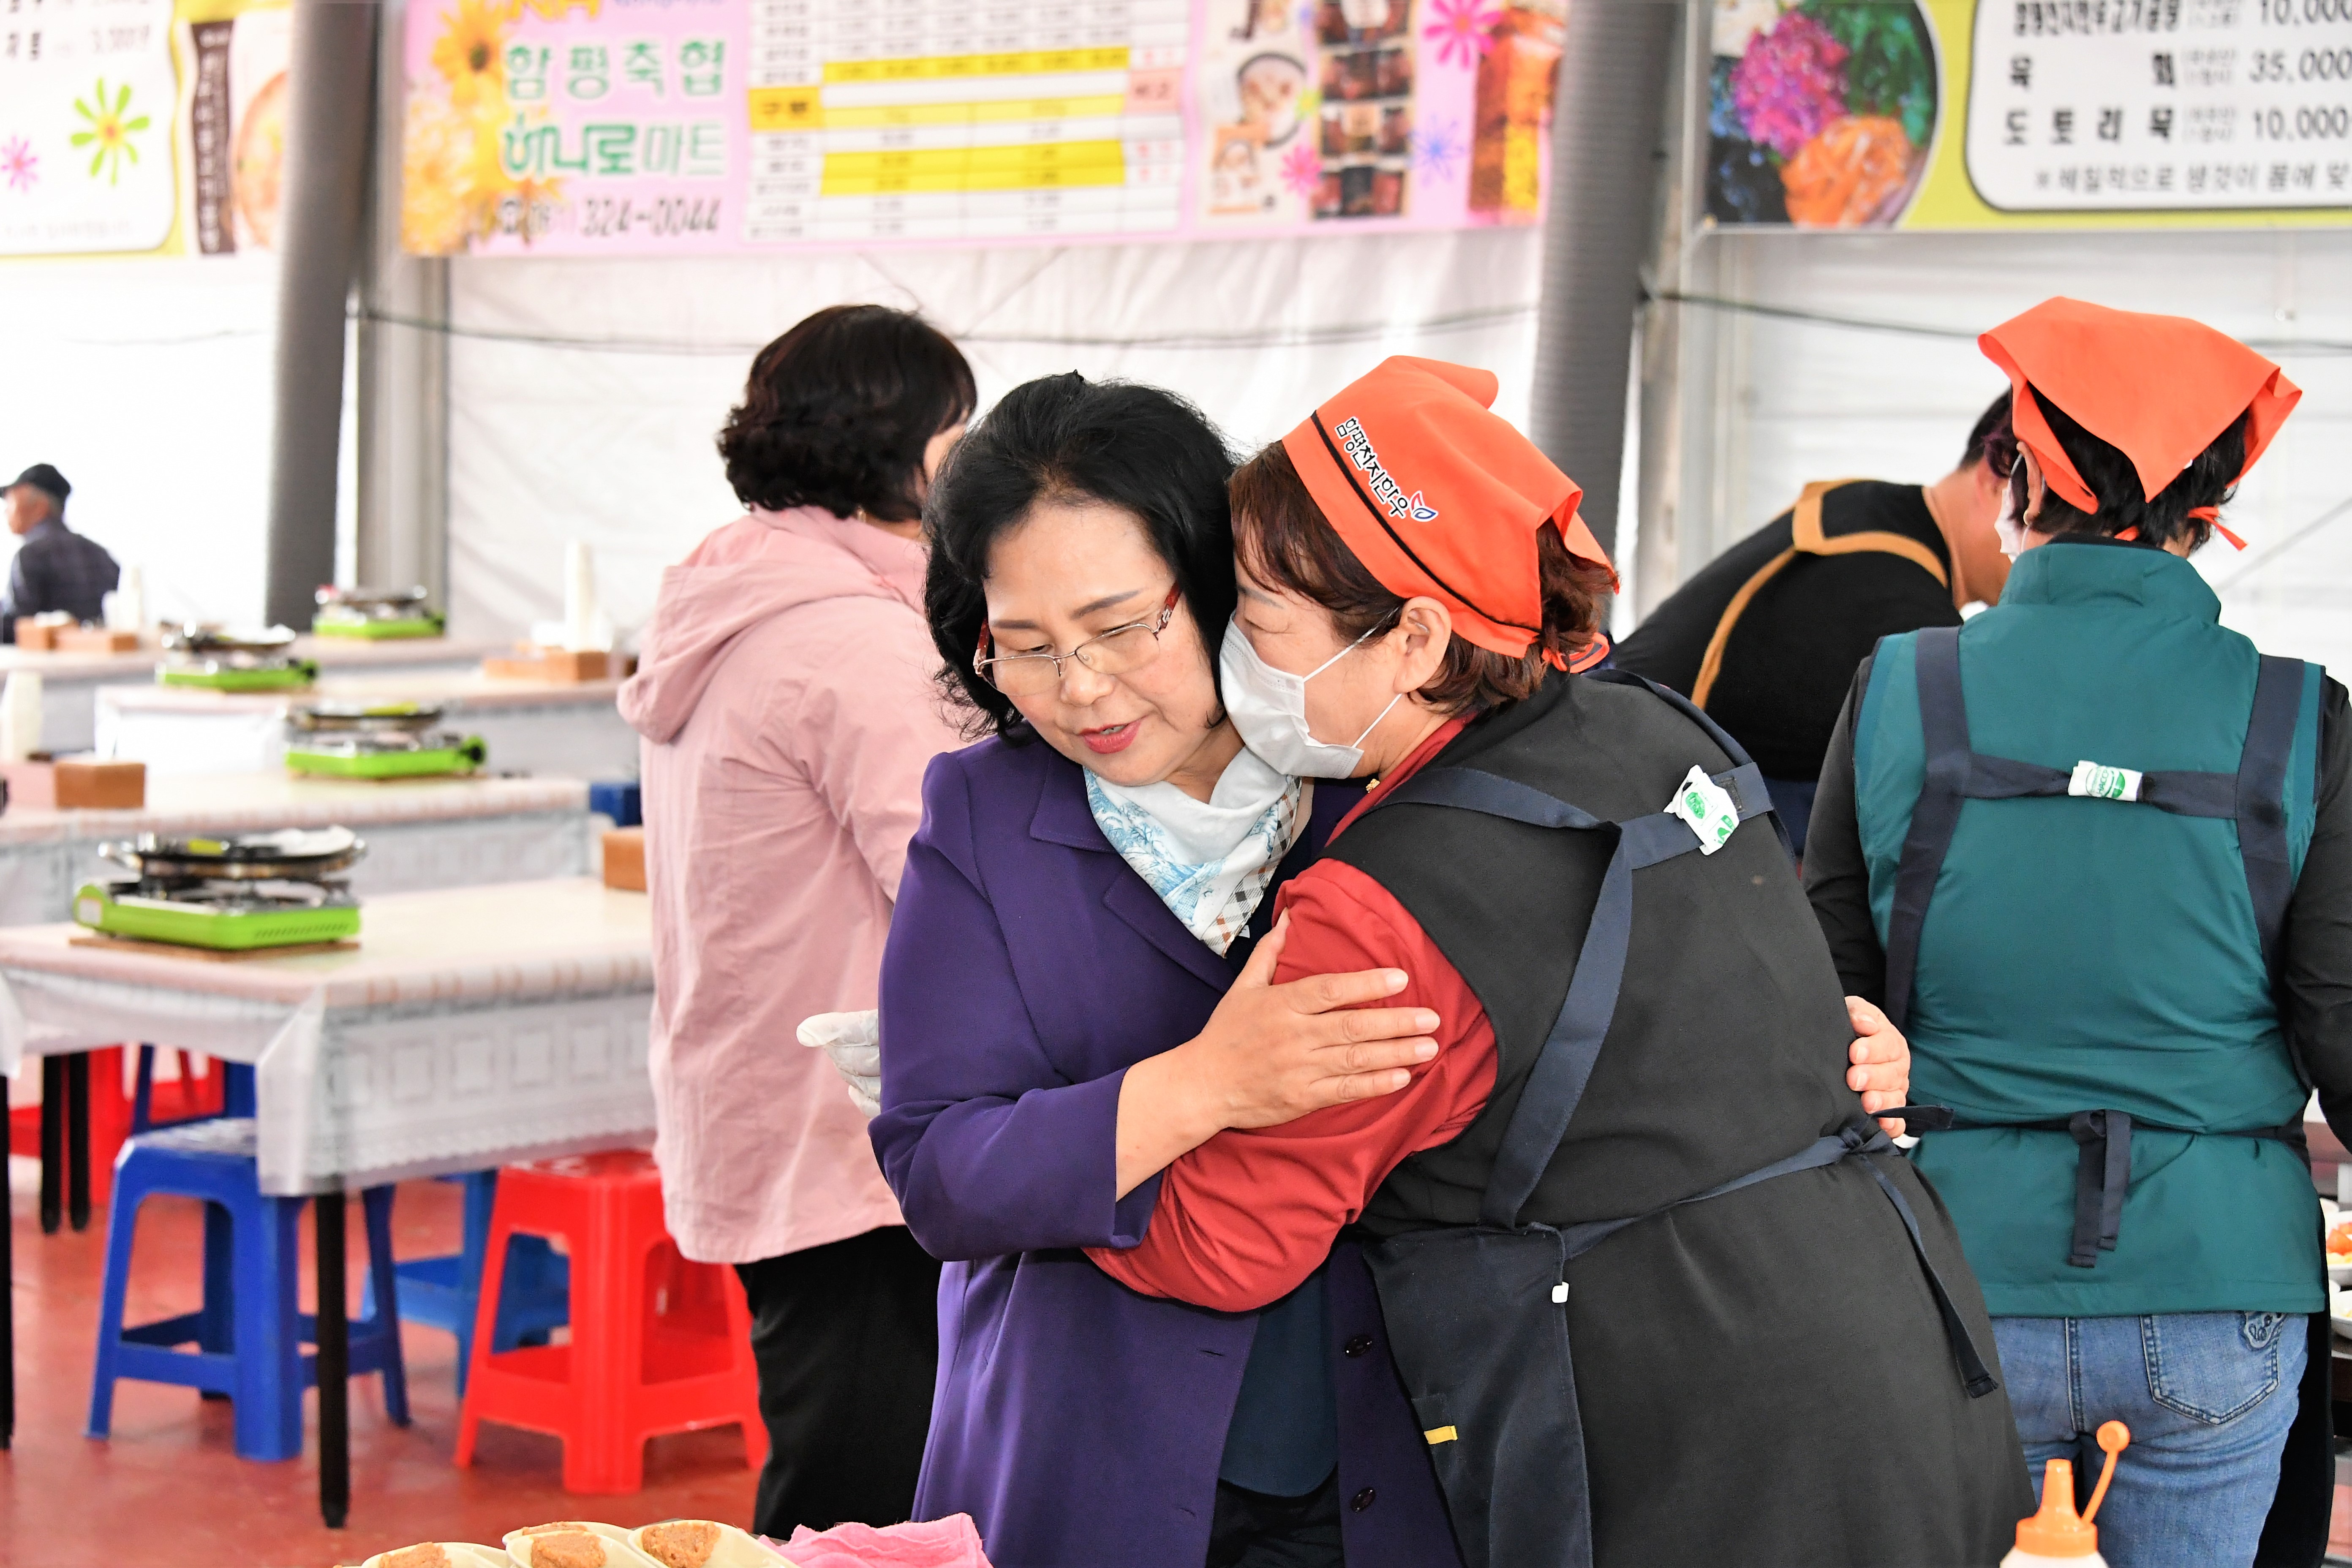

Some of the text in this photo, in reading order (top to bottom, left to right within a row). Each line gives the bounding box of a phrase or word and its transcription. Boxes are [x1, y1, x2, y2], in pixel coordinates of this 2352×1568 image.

[504, 112, 727, 175] 하나로마트
[1336, 417, 1409, 518] 함평천지한우
[2096, 768, 2110, 795] HACCP
